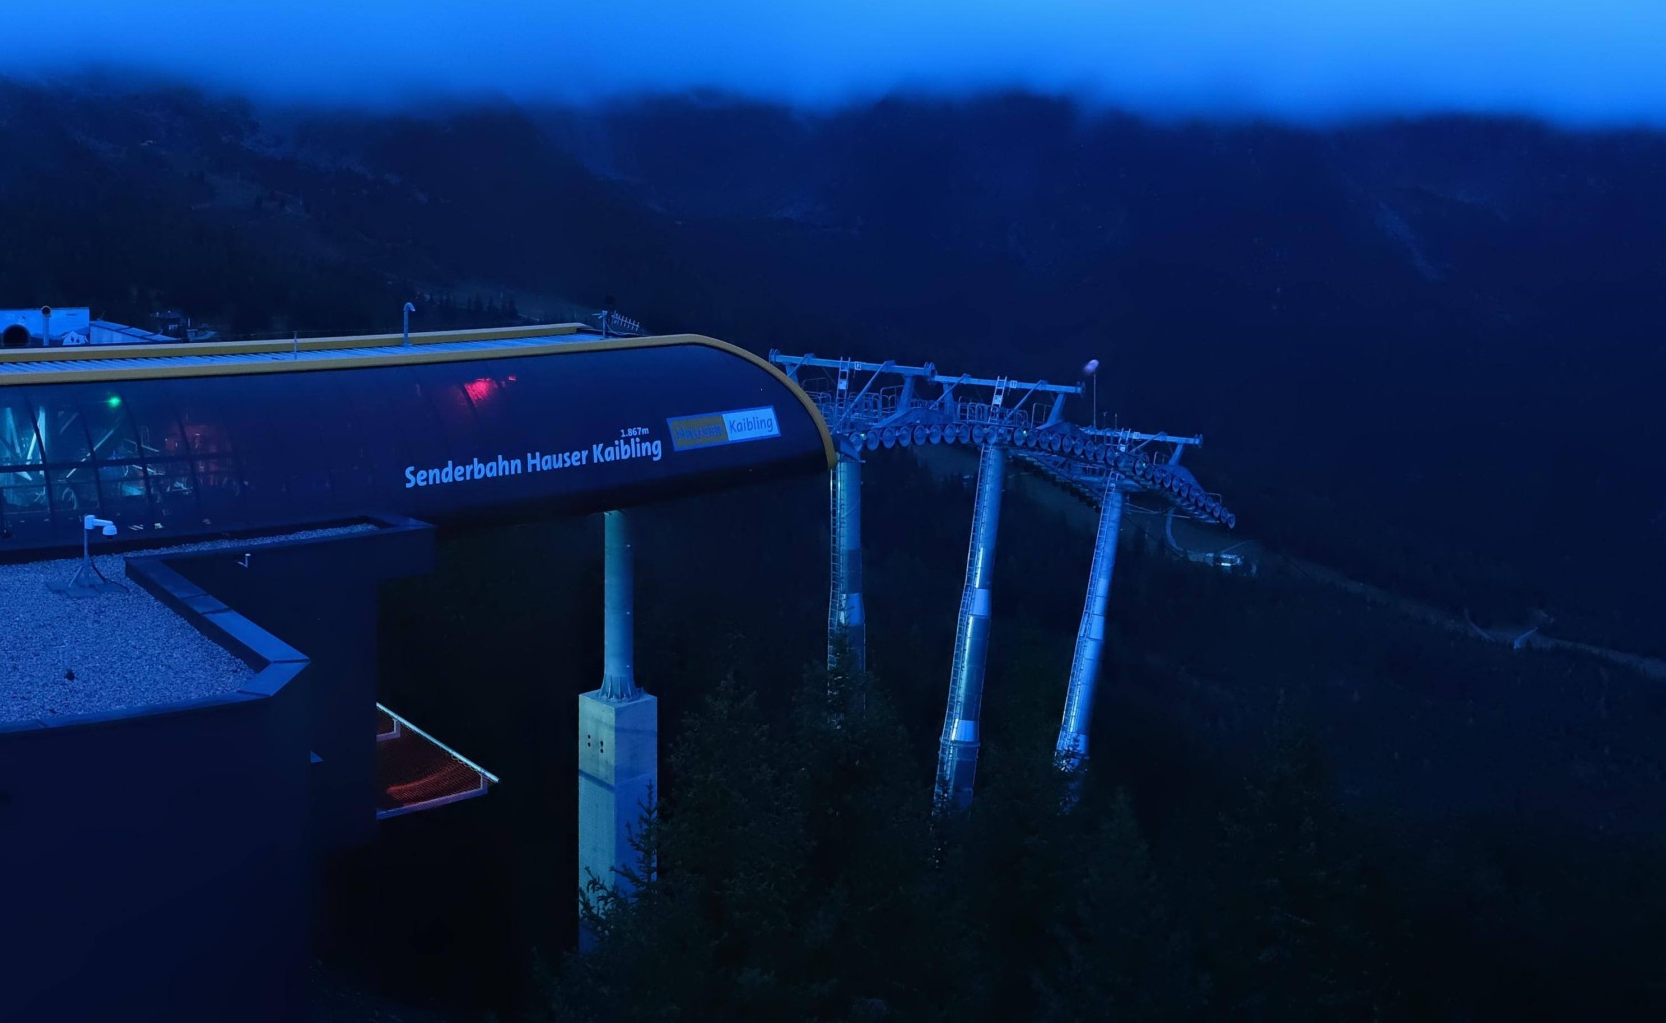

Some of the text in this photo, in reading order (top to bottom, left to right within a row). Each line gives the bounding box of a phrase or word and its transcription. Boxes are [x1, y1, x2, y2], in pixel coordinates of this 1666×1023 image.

[620, 426, 649, 438] 1.867m
[728, 414, 774, 434] Kaibling
[405, 437, 662, 488] Senderbahn Hauser Kaibling
